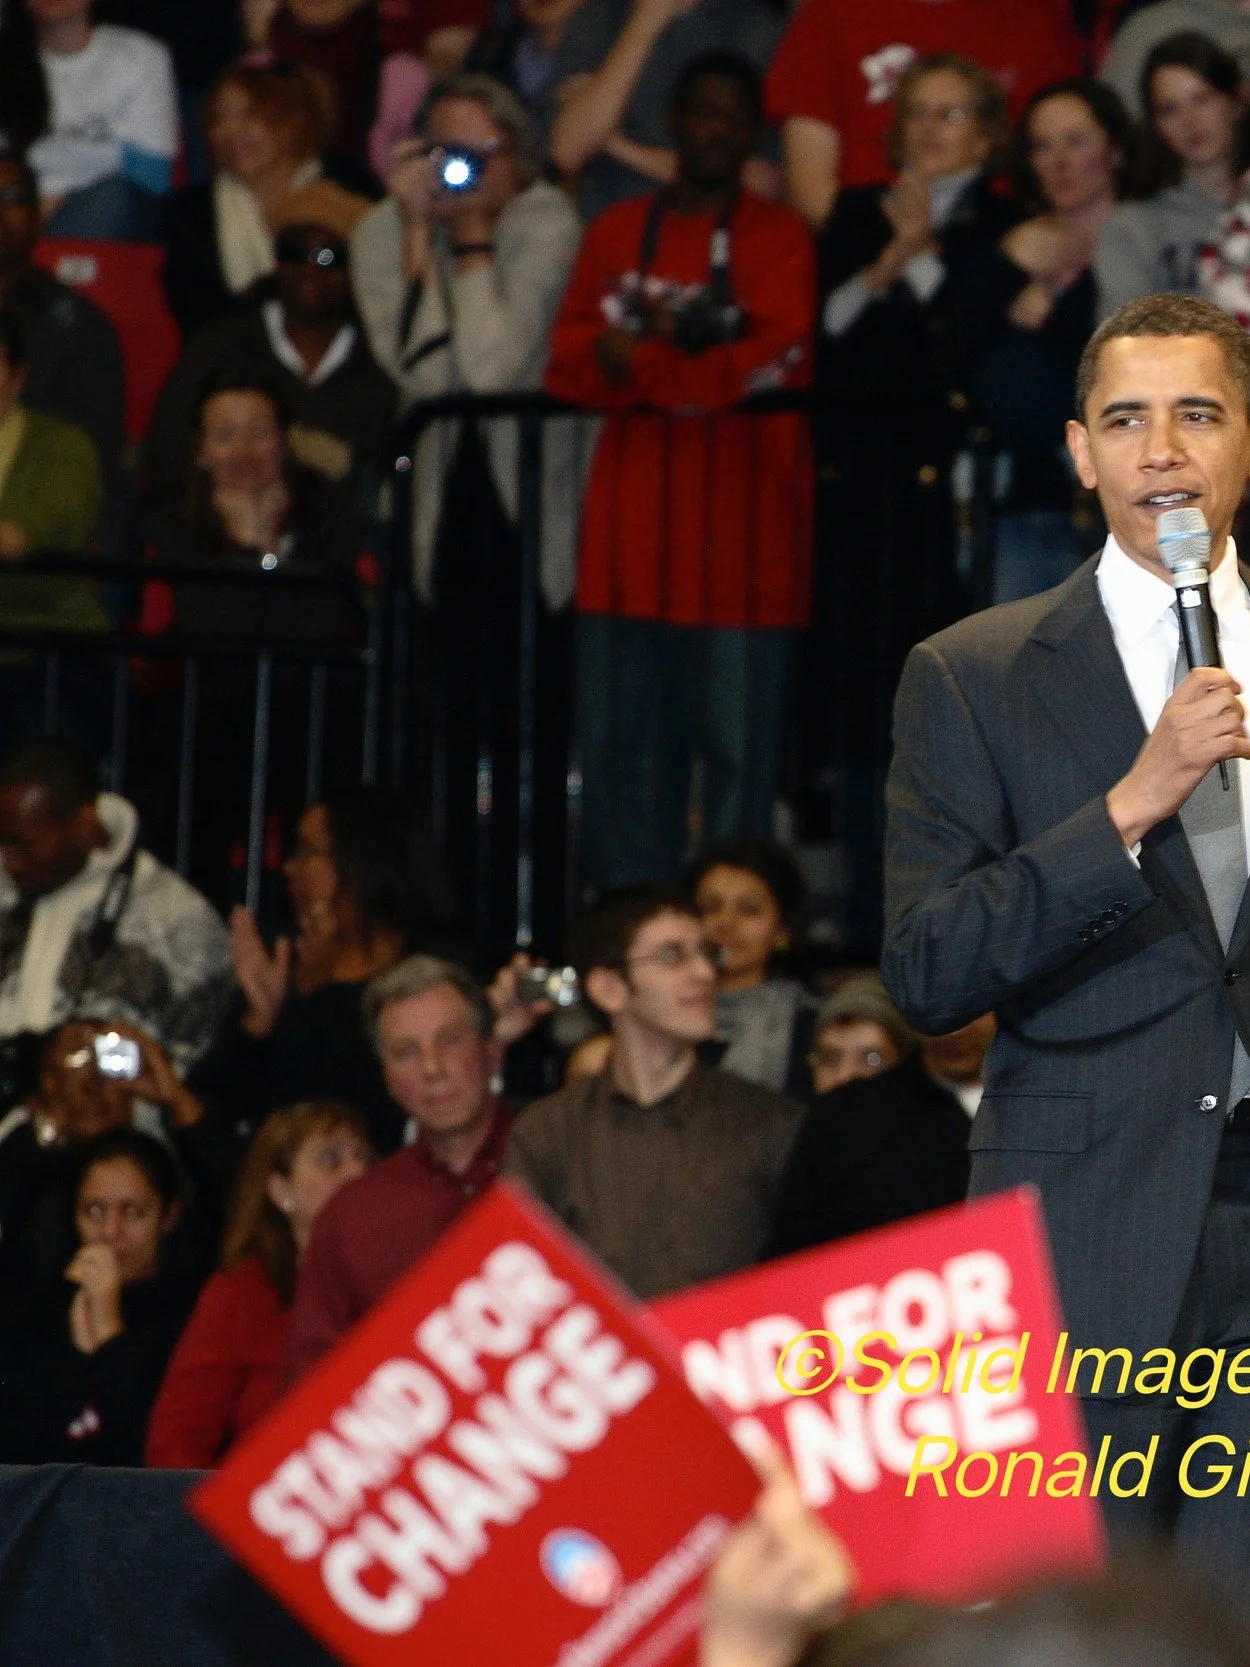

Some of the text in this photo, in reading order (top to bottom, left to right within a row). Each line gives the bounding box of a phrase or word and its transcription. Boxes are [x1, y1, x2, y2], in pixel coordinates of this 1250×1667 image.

[248, 1240, 576, 1562] STAND FOR
[317, 1304, 659, 1637] CHANGE
[820, 1247, 1023, 1378] FOR
